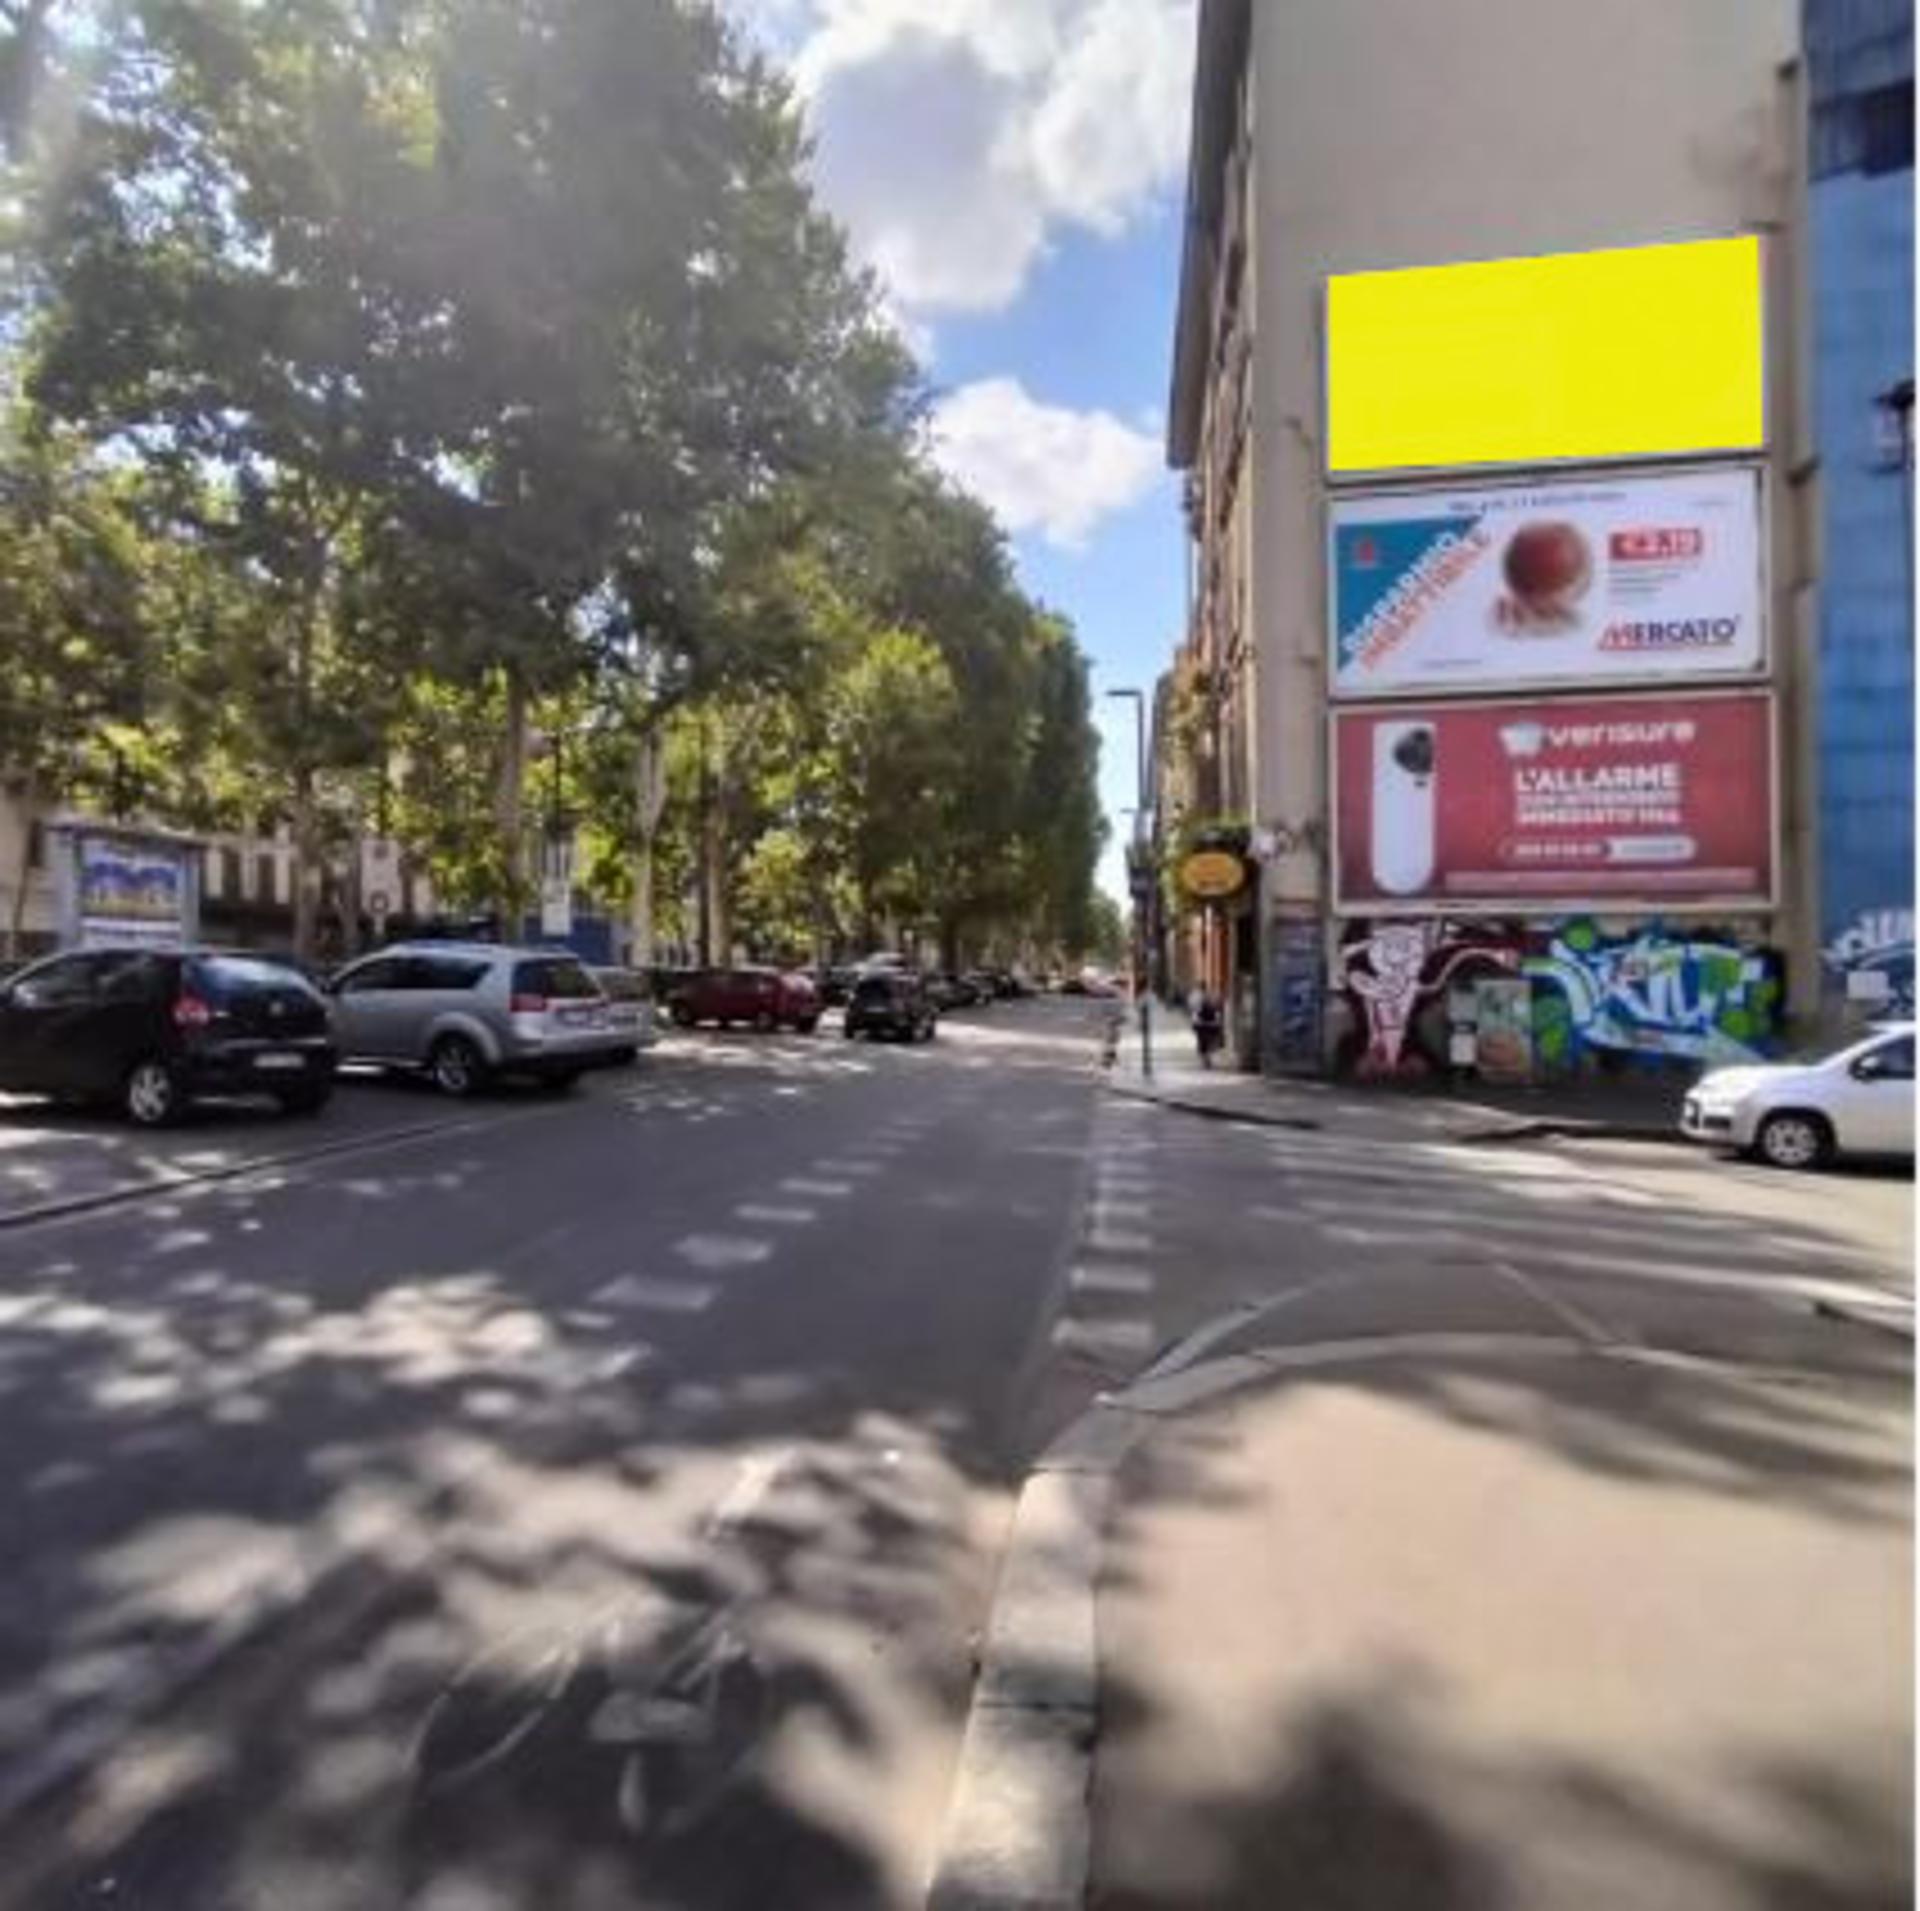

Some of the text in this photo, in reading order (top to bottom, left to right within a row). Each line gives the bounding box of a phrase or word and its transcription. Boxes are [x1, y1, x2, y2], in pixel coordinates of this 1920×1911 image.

[1600, 617, 1736, 650] MERCATO
[1547, 720, 1696, 747] verisure
[1514, 764, 1682, 793] L'ALLARME
